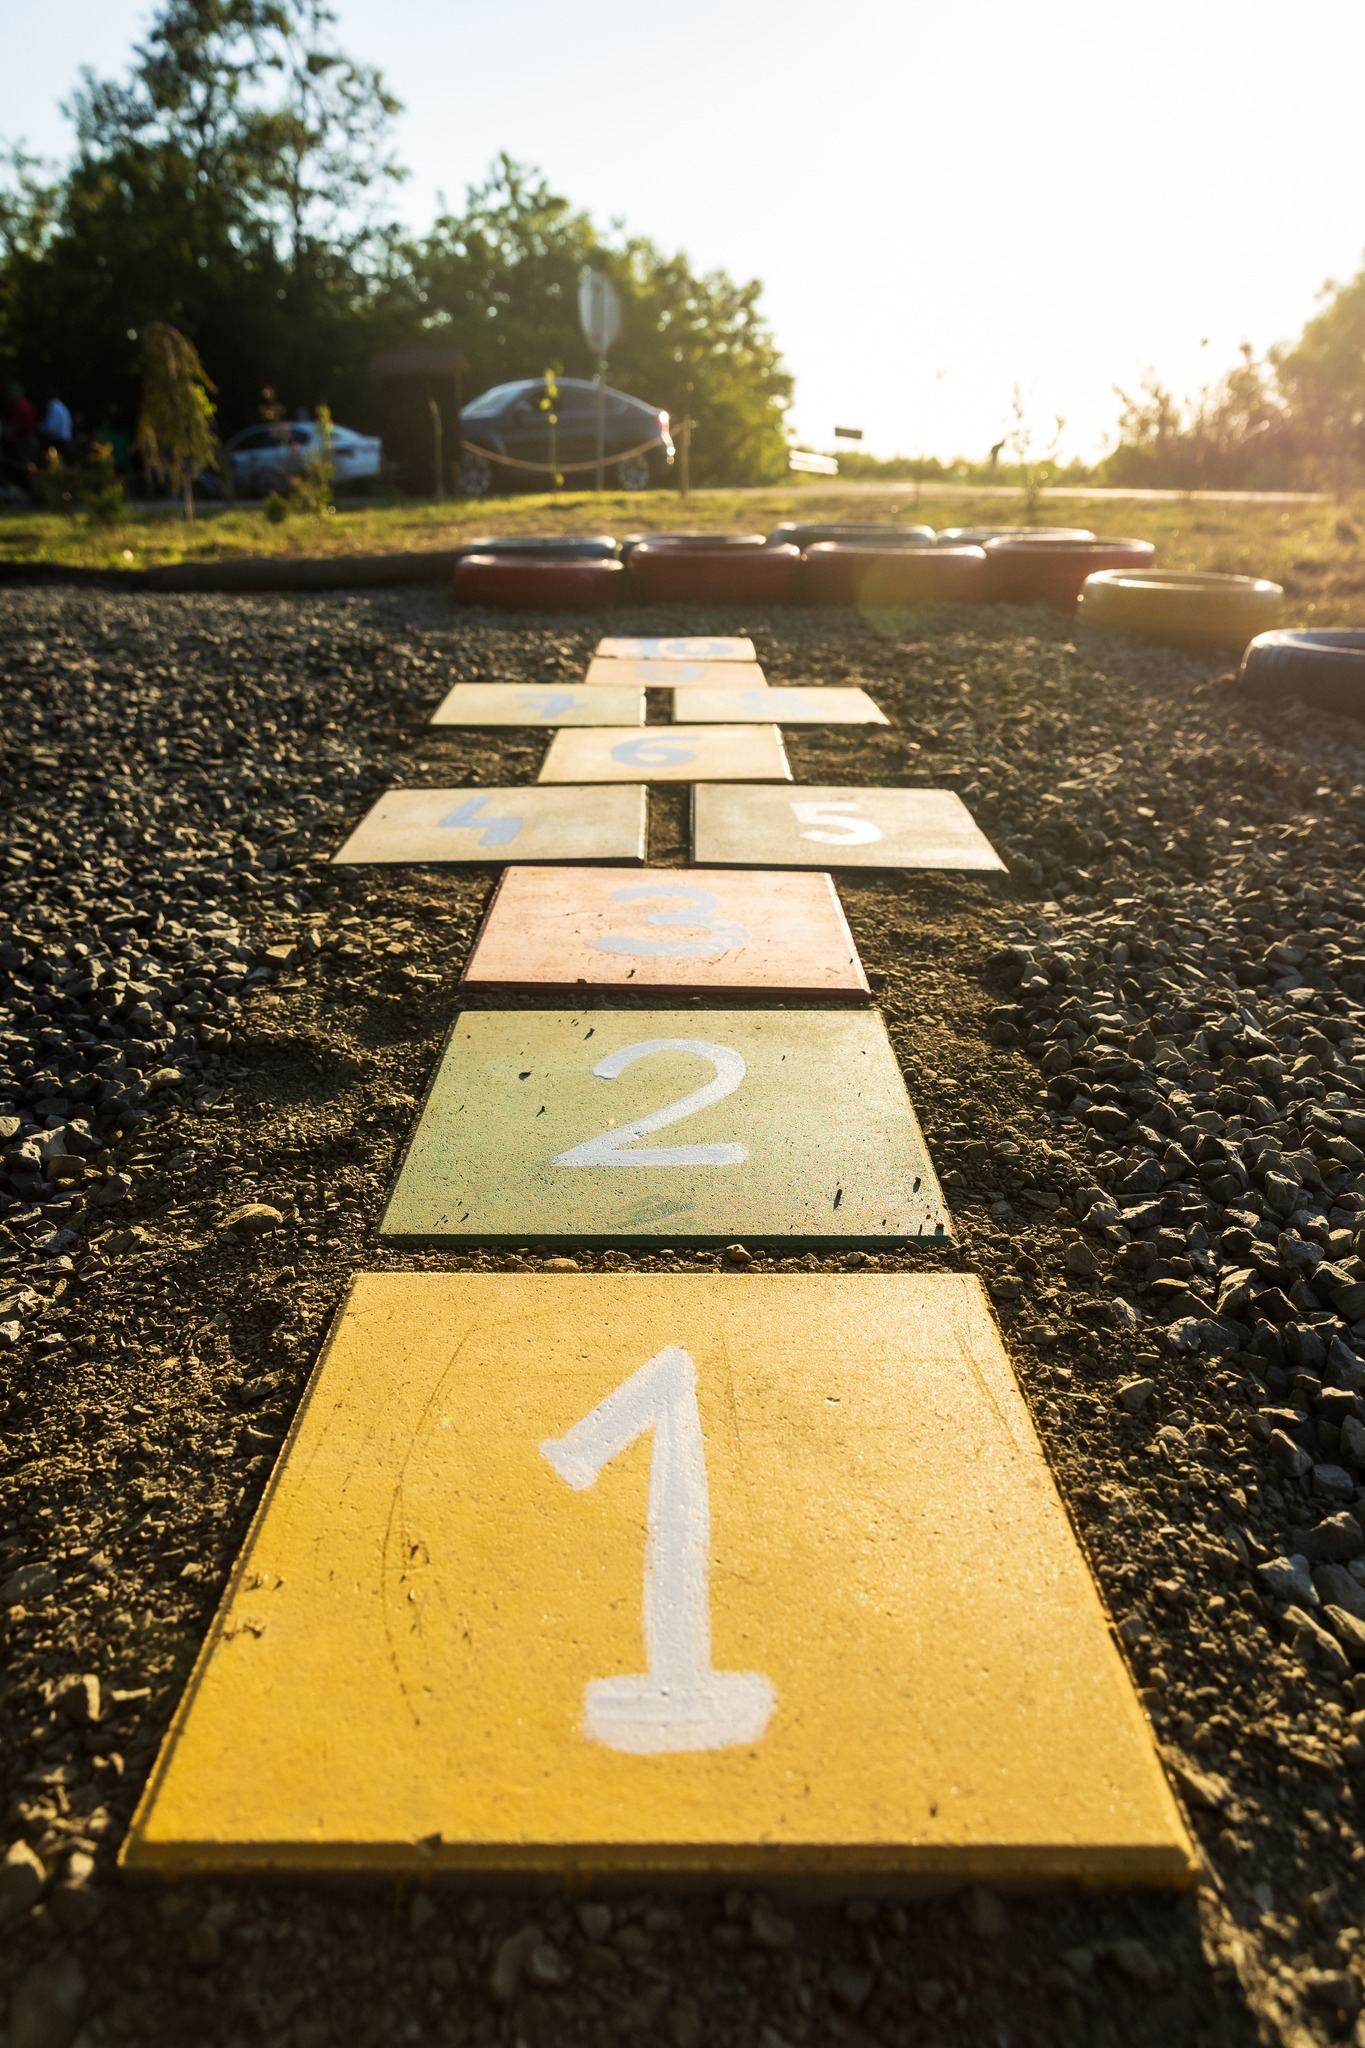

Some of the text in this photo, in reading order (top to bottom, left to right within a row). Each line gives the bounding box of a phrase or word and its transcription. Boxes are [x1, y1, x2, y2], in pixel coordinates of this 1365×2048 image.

[623, 637, 733, 658] 10
[517, 693, 586, 718] 7
[740, 690, 818, 714] 8
[611, 736, 696, 767] 6
[439, 798, 524, 846] 4
[790, 802, 882, 846] 5
[588, 886, 751, 957] 3
[552, 1039, 747, 1167] 2
[540, 1345, 777, 1755] 1
